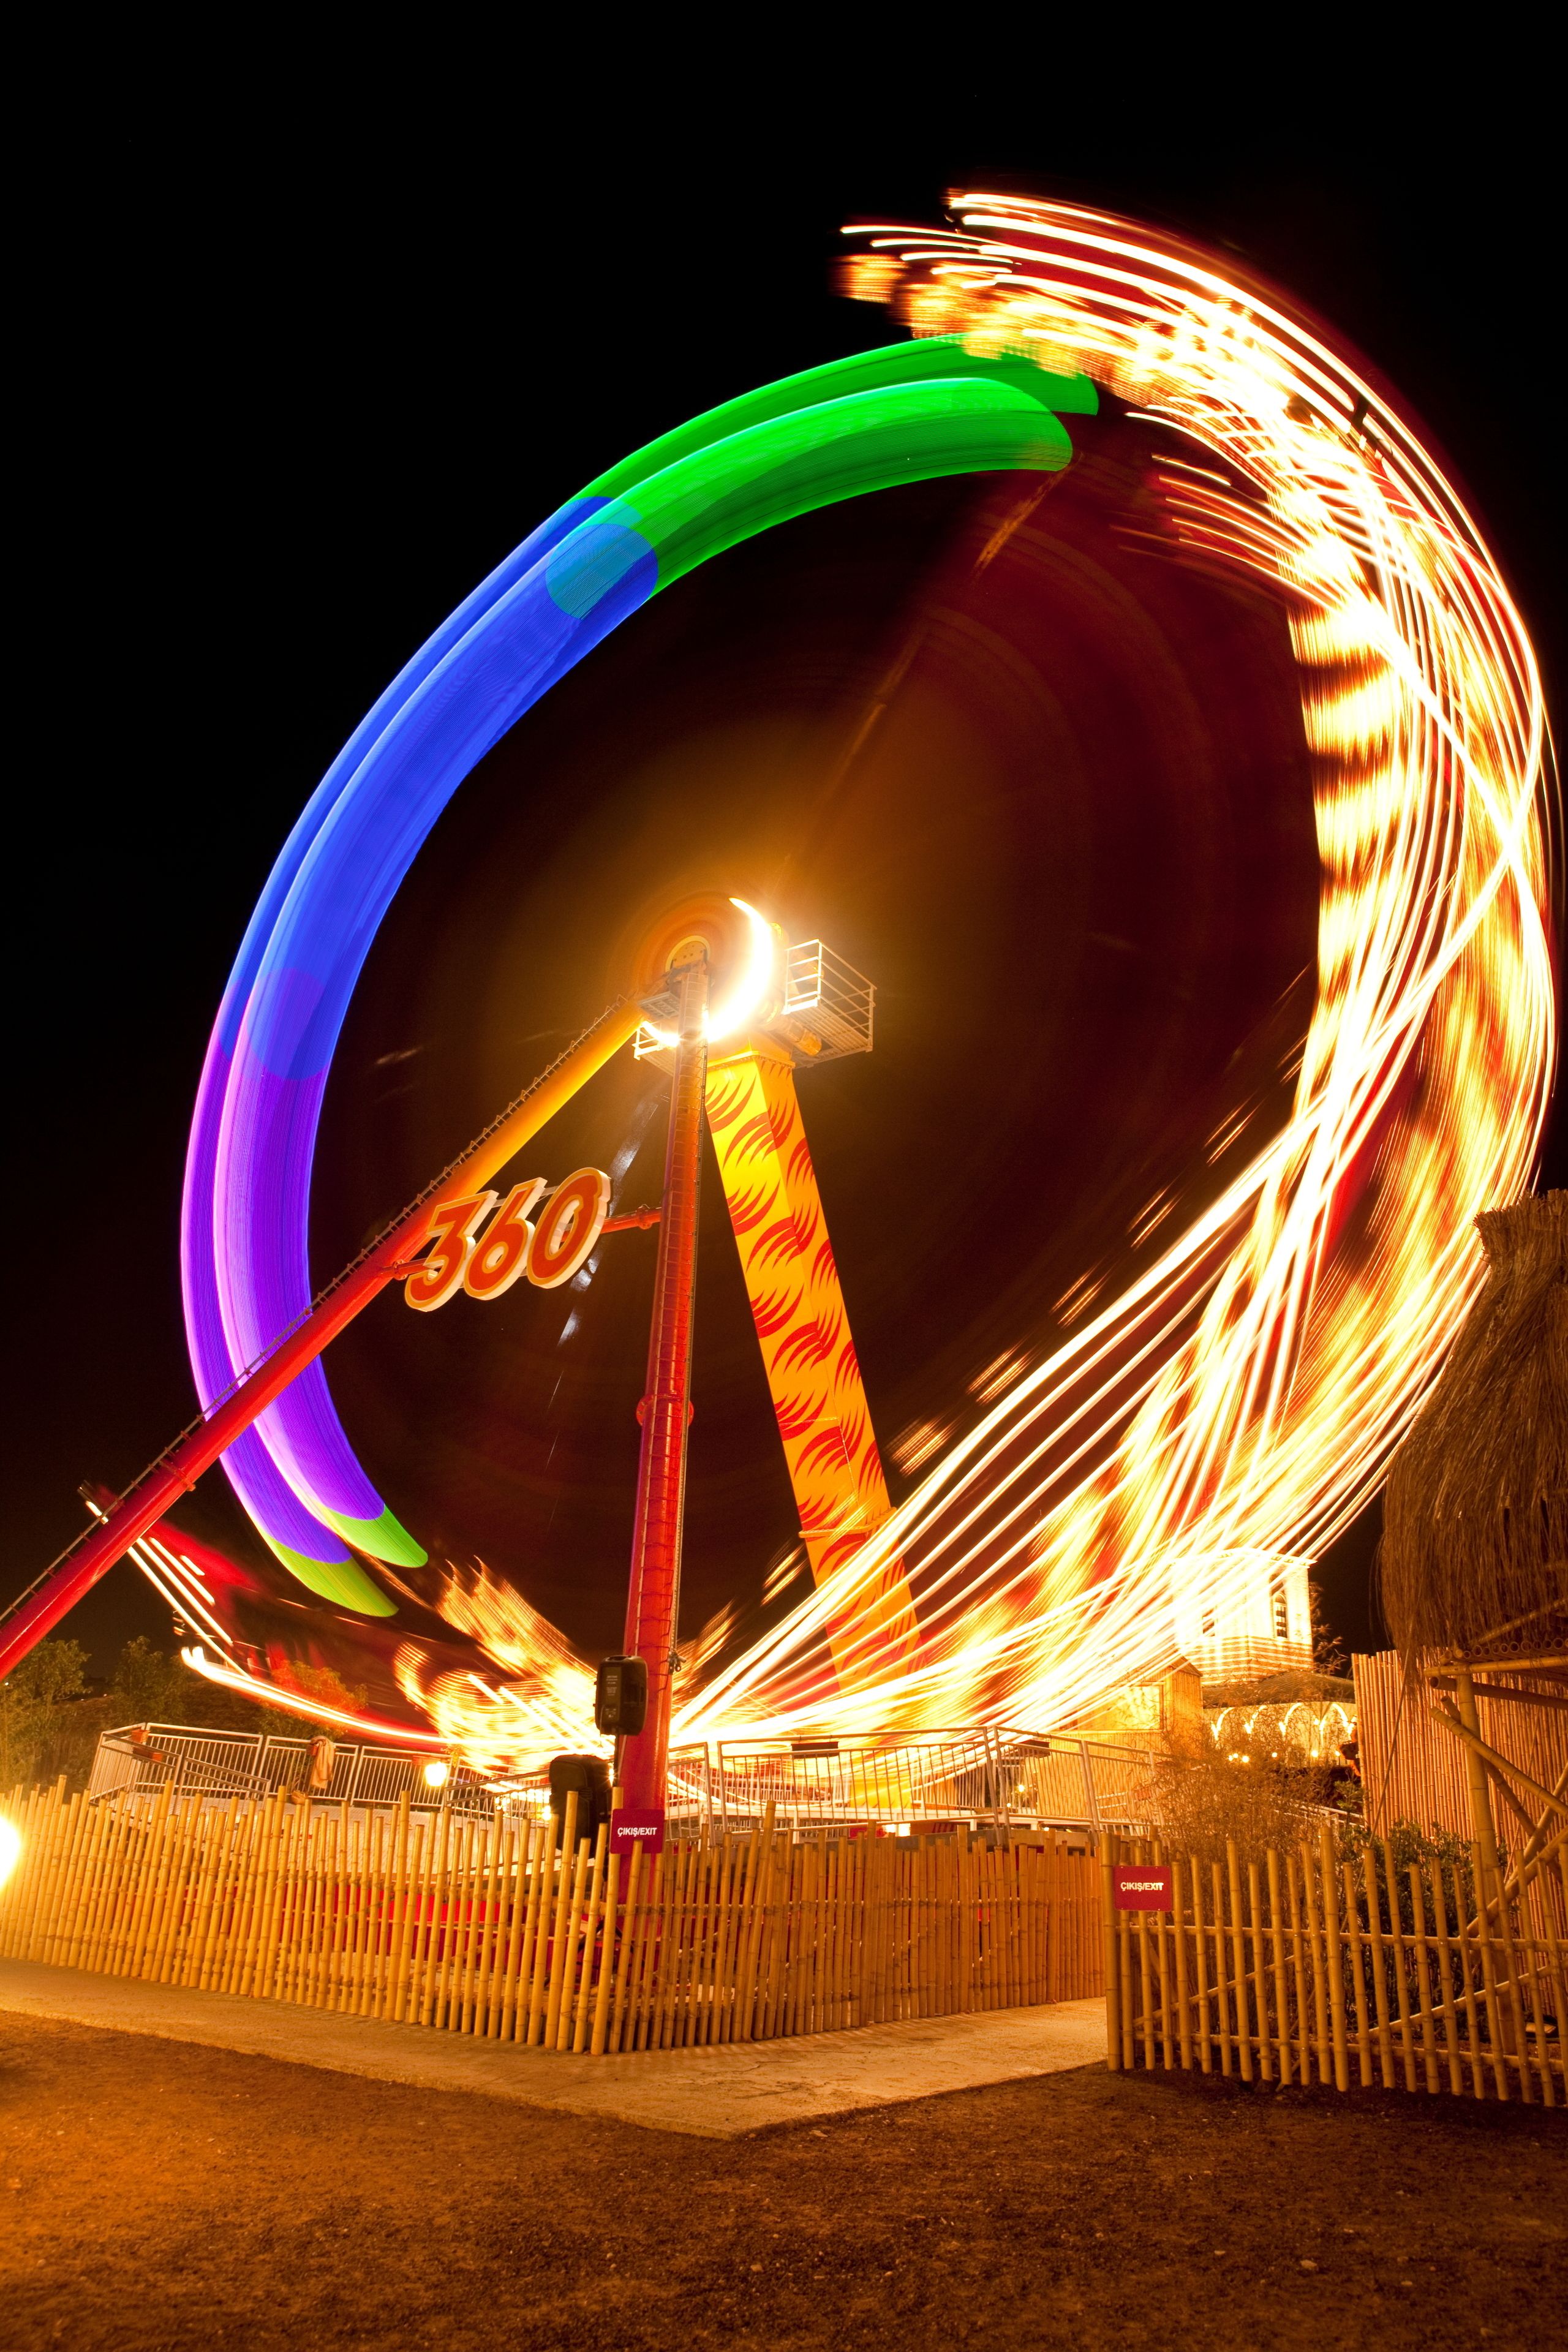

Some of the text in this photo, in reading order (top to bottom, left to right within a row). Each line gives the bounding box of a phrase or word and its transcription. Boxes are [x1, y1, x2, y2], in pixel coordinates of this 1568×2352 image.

[405, 1167, 611, 1312] 360
[617, 1827, 657, 1837] ÇIKIŞ/EXIT
[1120, 1882, 1164, 1891] ÇIKIŞ/EXIT
